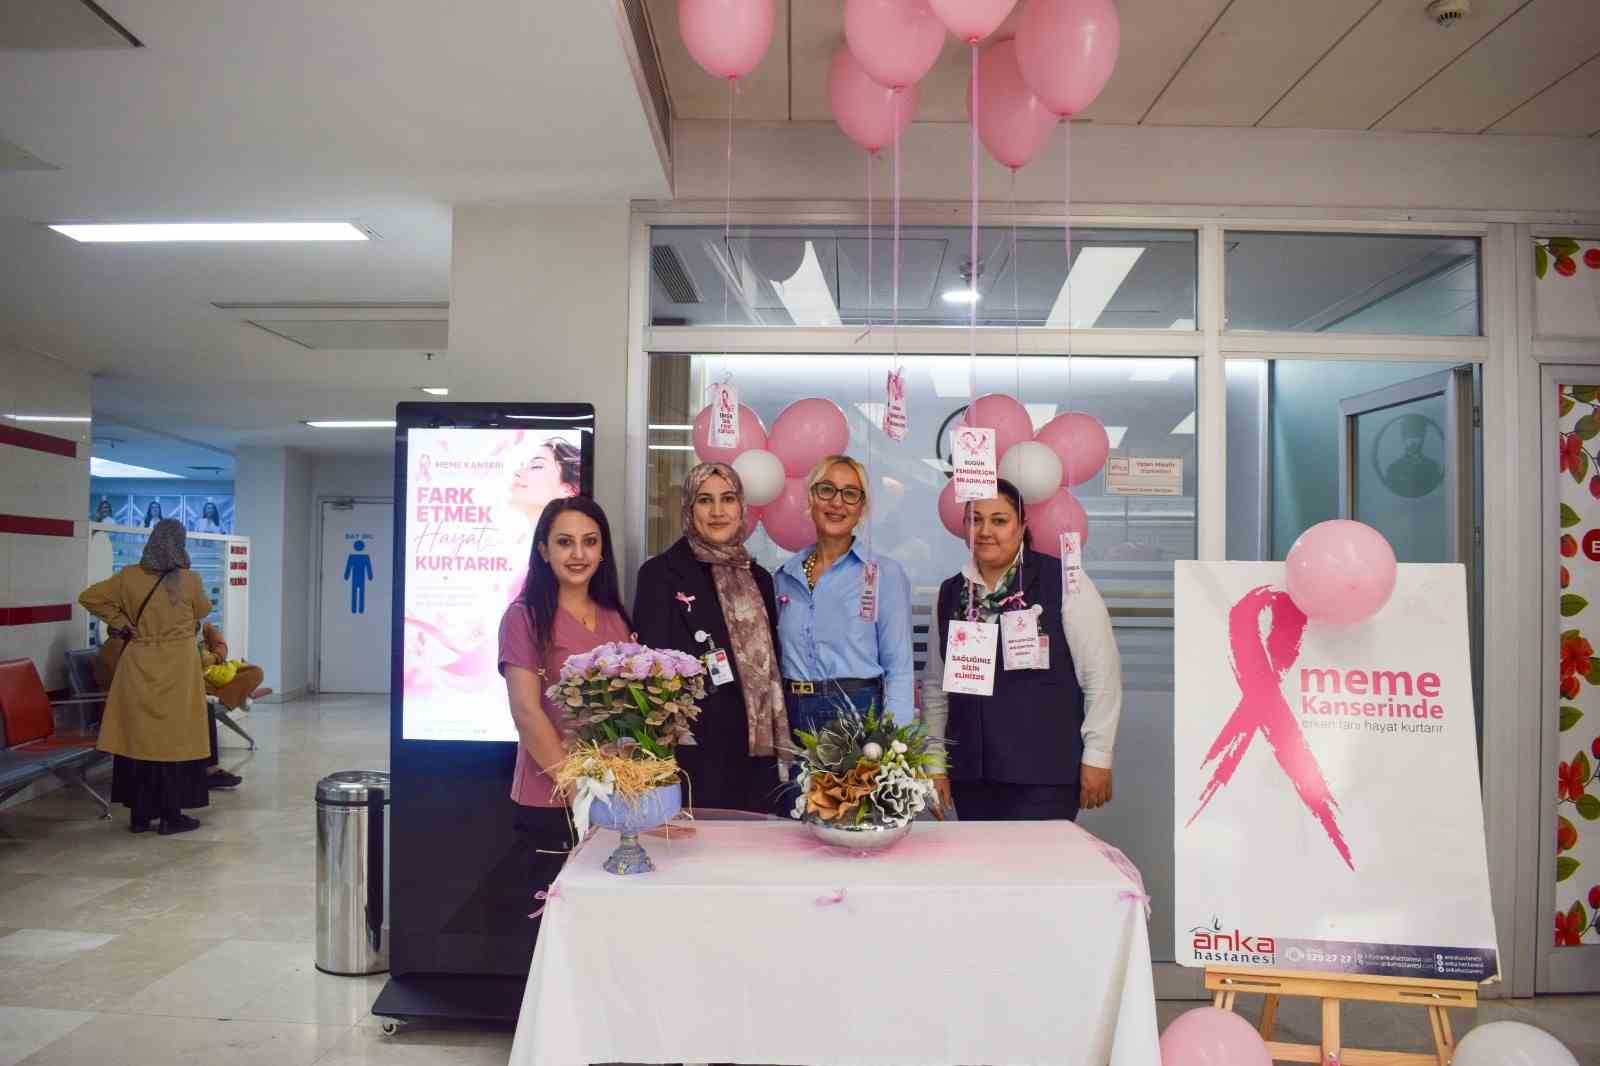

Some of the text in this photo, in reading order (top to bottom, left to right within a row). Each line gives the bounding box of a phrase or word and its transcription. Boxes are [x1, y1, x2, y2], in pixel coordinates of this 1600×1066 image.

[417, 486, 475, 504] FARK
[416, 505, 493, 523] ETMEK
[415, 555, 512, 572] KURTARIR.
[1300, 668, 1441, 697] meme
[1302, 696, 1444, 719] Kanserinde
[1364, 720, 1398, 734] hayat
[1401, 721, 1443, 734] kurtarır
[1193, 929, 1275, 953] anka
[1194, 949, 1275, 964] hastanesi
